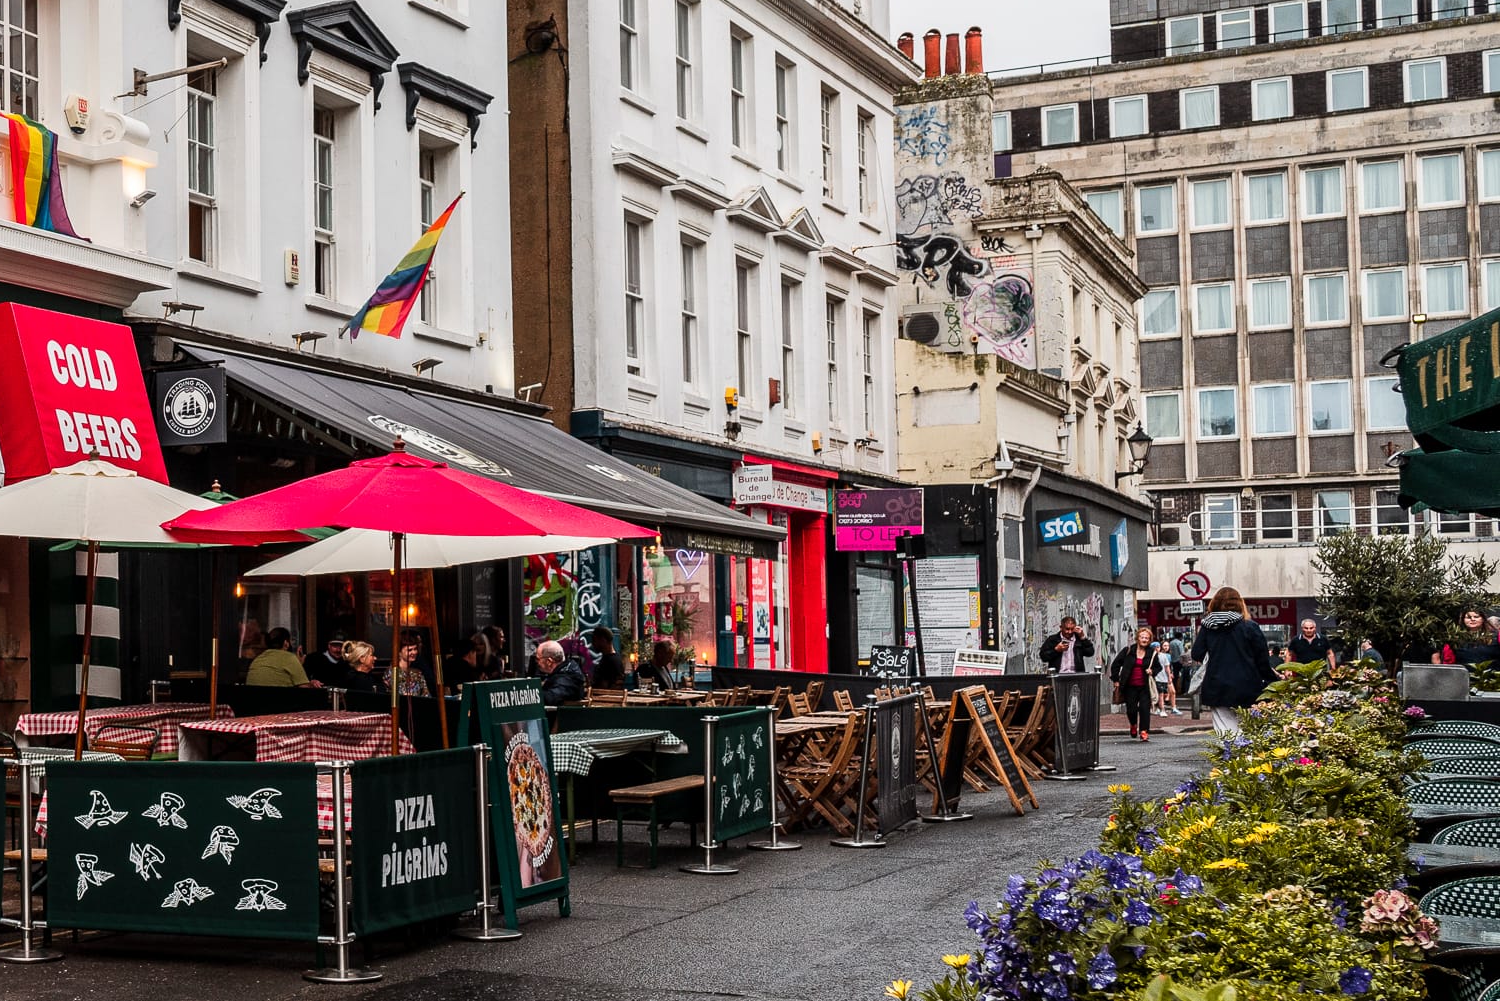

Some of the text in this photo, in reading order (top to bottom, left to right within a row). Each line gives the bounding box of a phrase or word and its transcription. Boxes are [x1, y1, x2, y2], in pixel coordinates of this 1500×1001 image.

[47, 339, 117, 391] COLD
[1417, 335, 1473, 408] THE
[168, 380, 211, 399] TRADING POST
[55, 408, 141, 461] BEERS
[738, 475, 769, 484] Bureau
[748, 484, 759, 492] de
[739, 493, 772, 502] Change
[786, 485, 808, 507] Change
[852, 527, 904, 541] TO LET
[1044, 517, 1078, 538] sta
[490, 691, 510, 708] PIZZA
[394, 794, 436, 832] PIZZA
